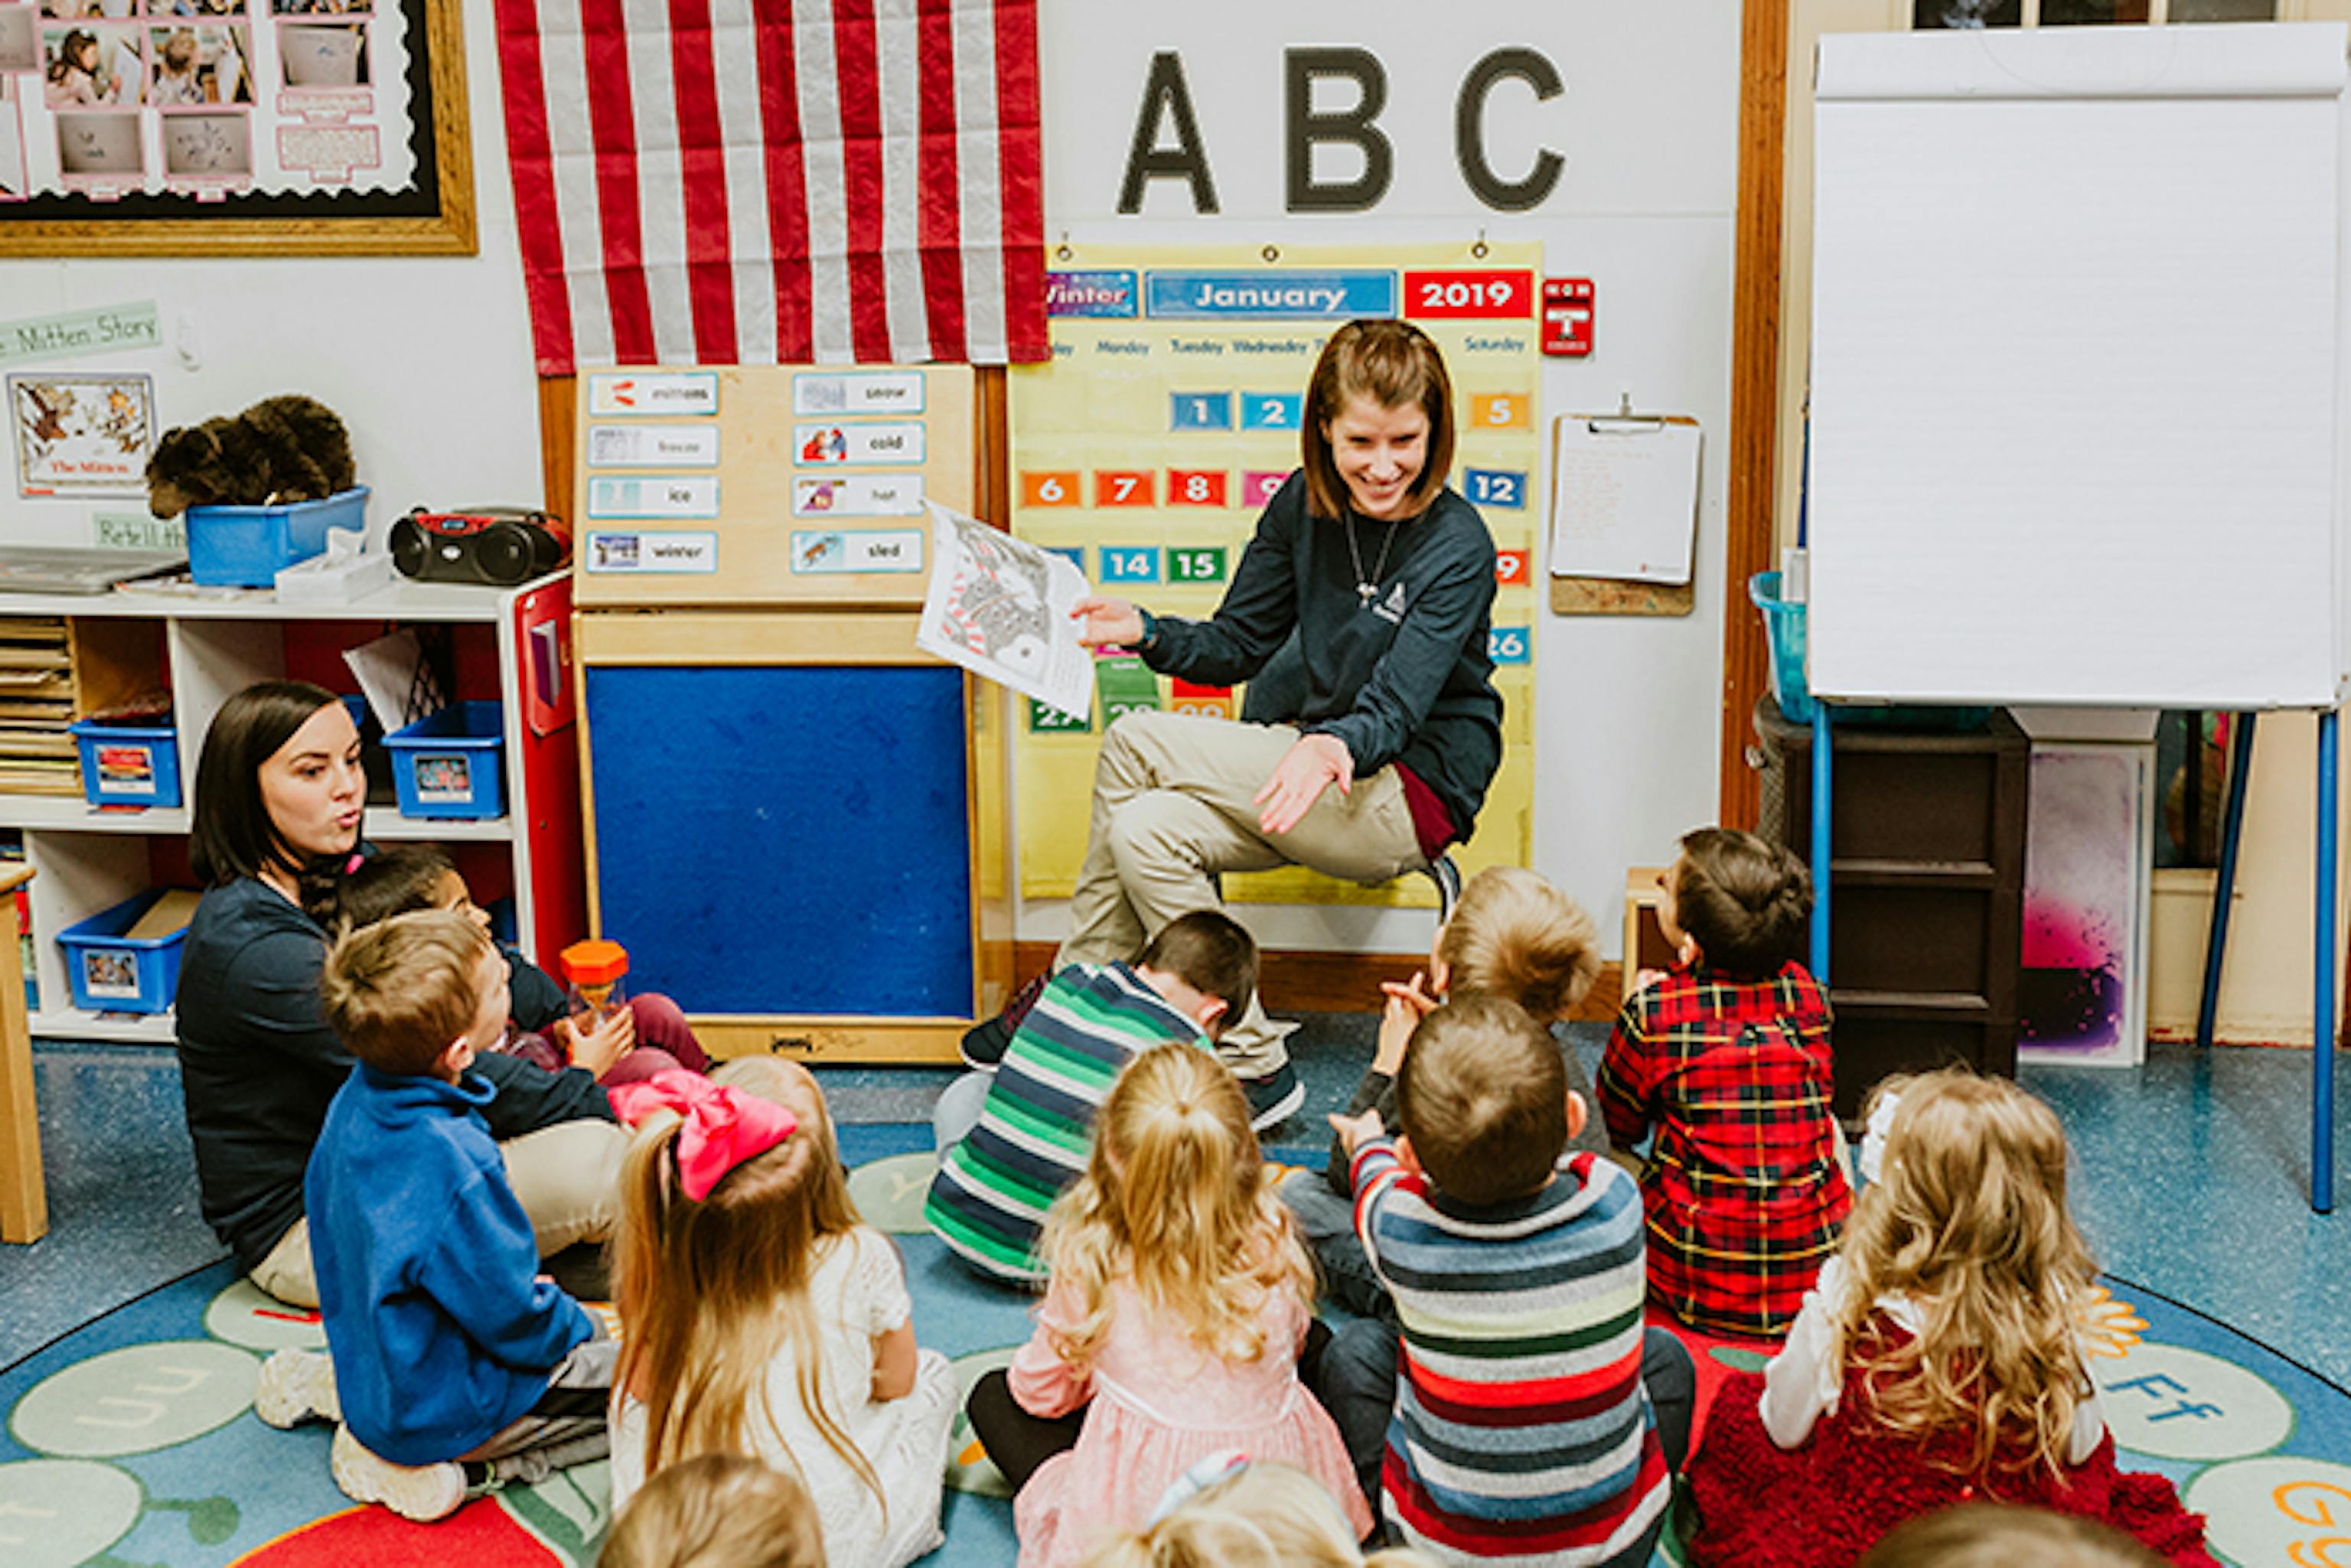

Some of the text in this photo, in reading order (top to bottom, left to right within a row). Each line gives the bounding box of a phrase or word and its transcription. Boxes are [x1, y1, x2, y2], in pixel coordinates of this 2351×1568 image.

[1195, 283, 1347, 311] January
[1420, 281, 1513, 308] 2019
[1096, 341, 1149, 356] Monday
[1169, 338, 1224, 355] Tuesday
[1232, 340, 1307, 355] Wednesday
[1464, 337, 1524, 352] Saturday
[1192, 399, 1512, 424] 1 2 5
[869, 435, 904, 450] cold
[668, 487, 690, 503] ice
[1039, 478, 1063, 502] 6
[1114, 478, 1137, 501] 7
[1185, 475, 1208, 501] 8
[1475, 474, 1515, 502] 12
[100, 520, 184, 548] Retell th
[652, 543, 703, 559] winter
[868, 544, 901, 558] sled
[1110, 553, 1520, 579] 14 15 9
[2104, 1373, 2225, 1422] Ff
